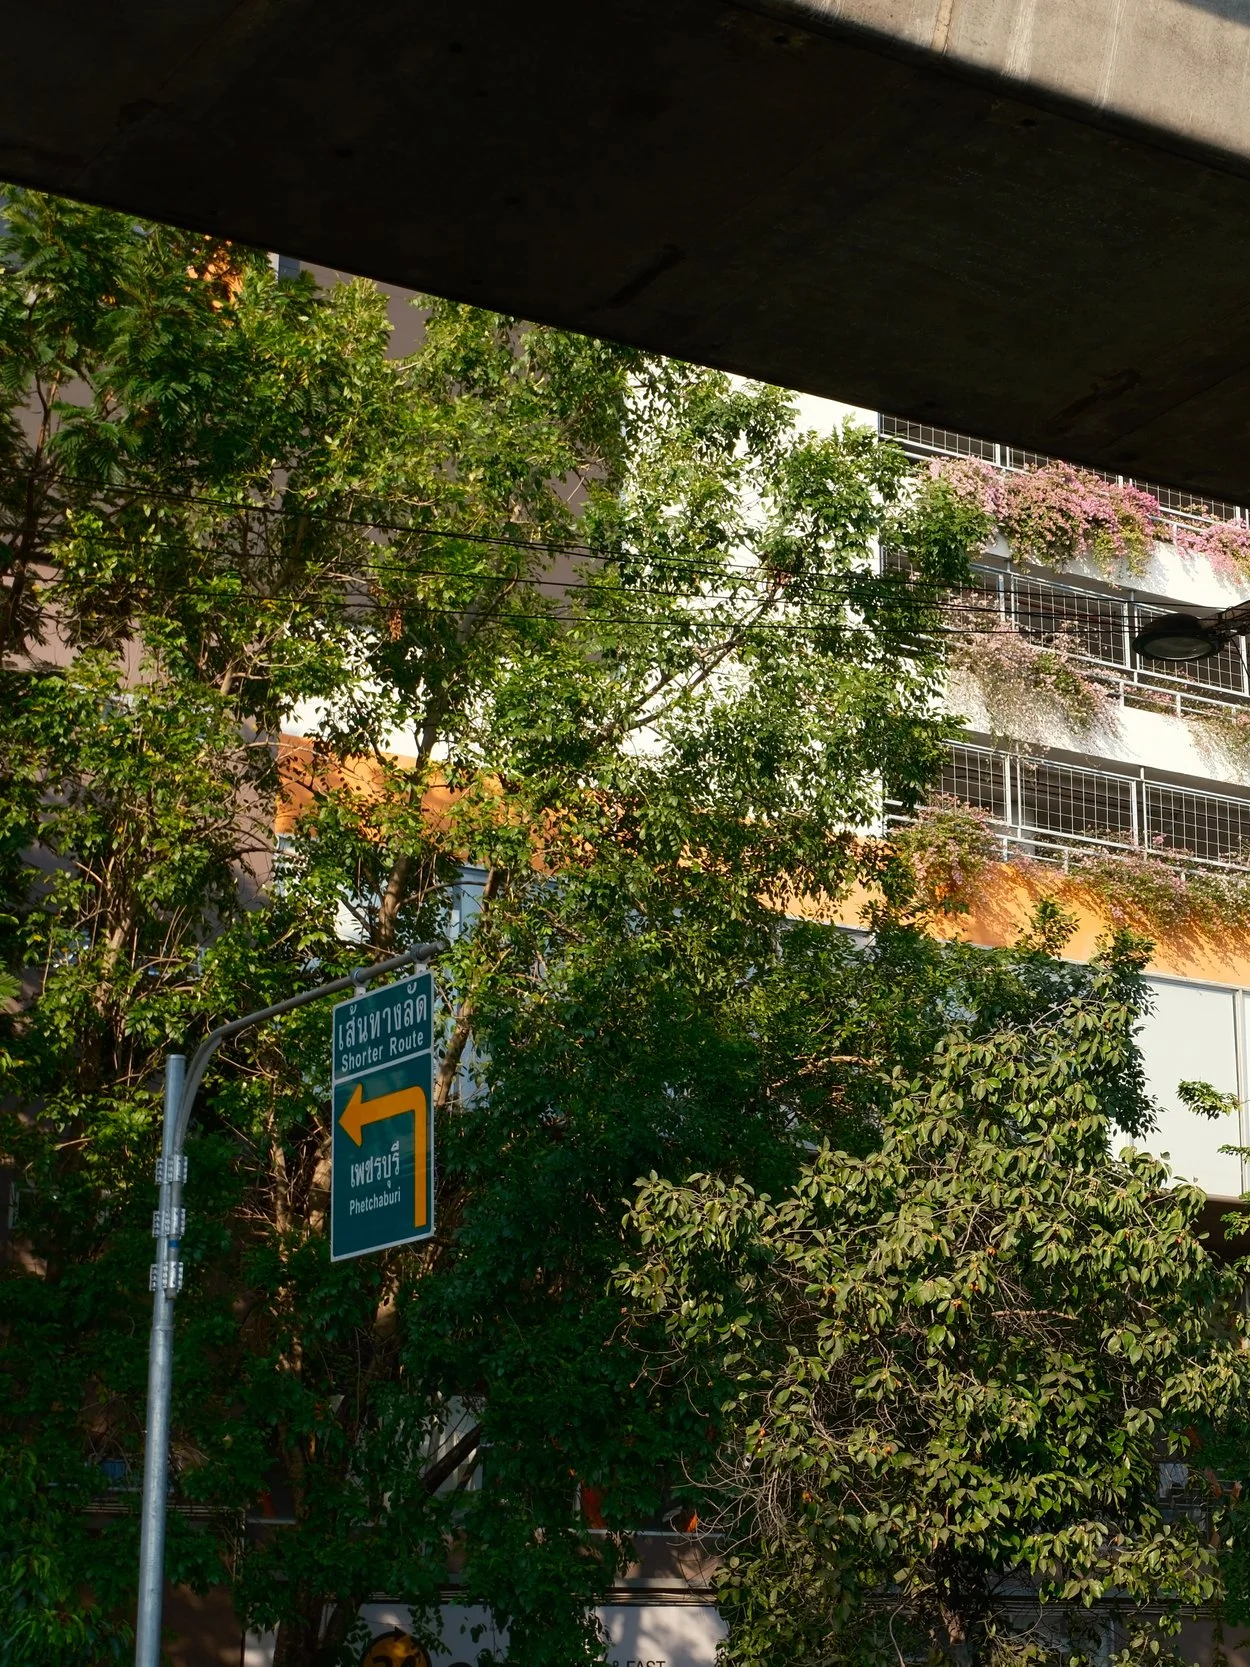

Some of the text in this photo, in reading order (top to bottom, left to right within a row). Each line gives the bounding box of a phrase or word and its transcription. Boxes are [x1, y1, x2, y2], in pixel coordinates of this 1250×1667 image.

[338, 981, 428, 1051] เส้นทางลัด
[341, 1030, 424, 1073] Shorter Route
[350, 1140, 400, 1189] เพชรบุรี
[349, 1186, 401, 1216] Phetchaburi
